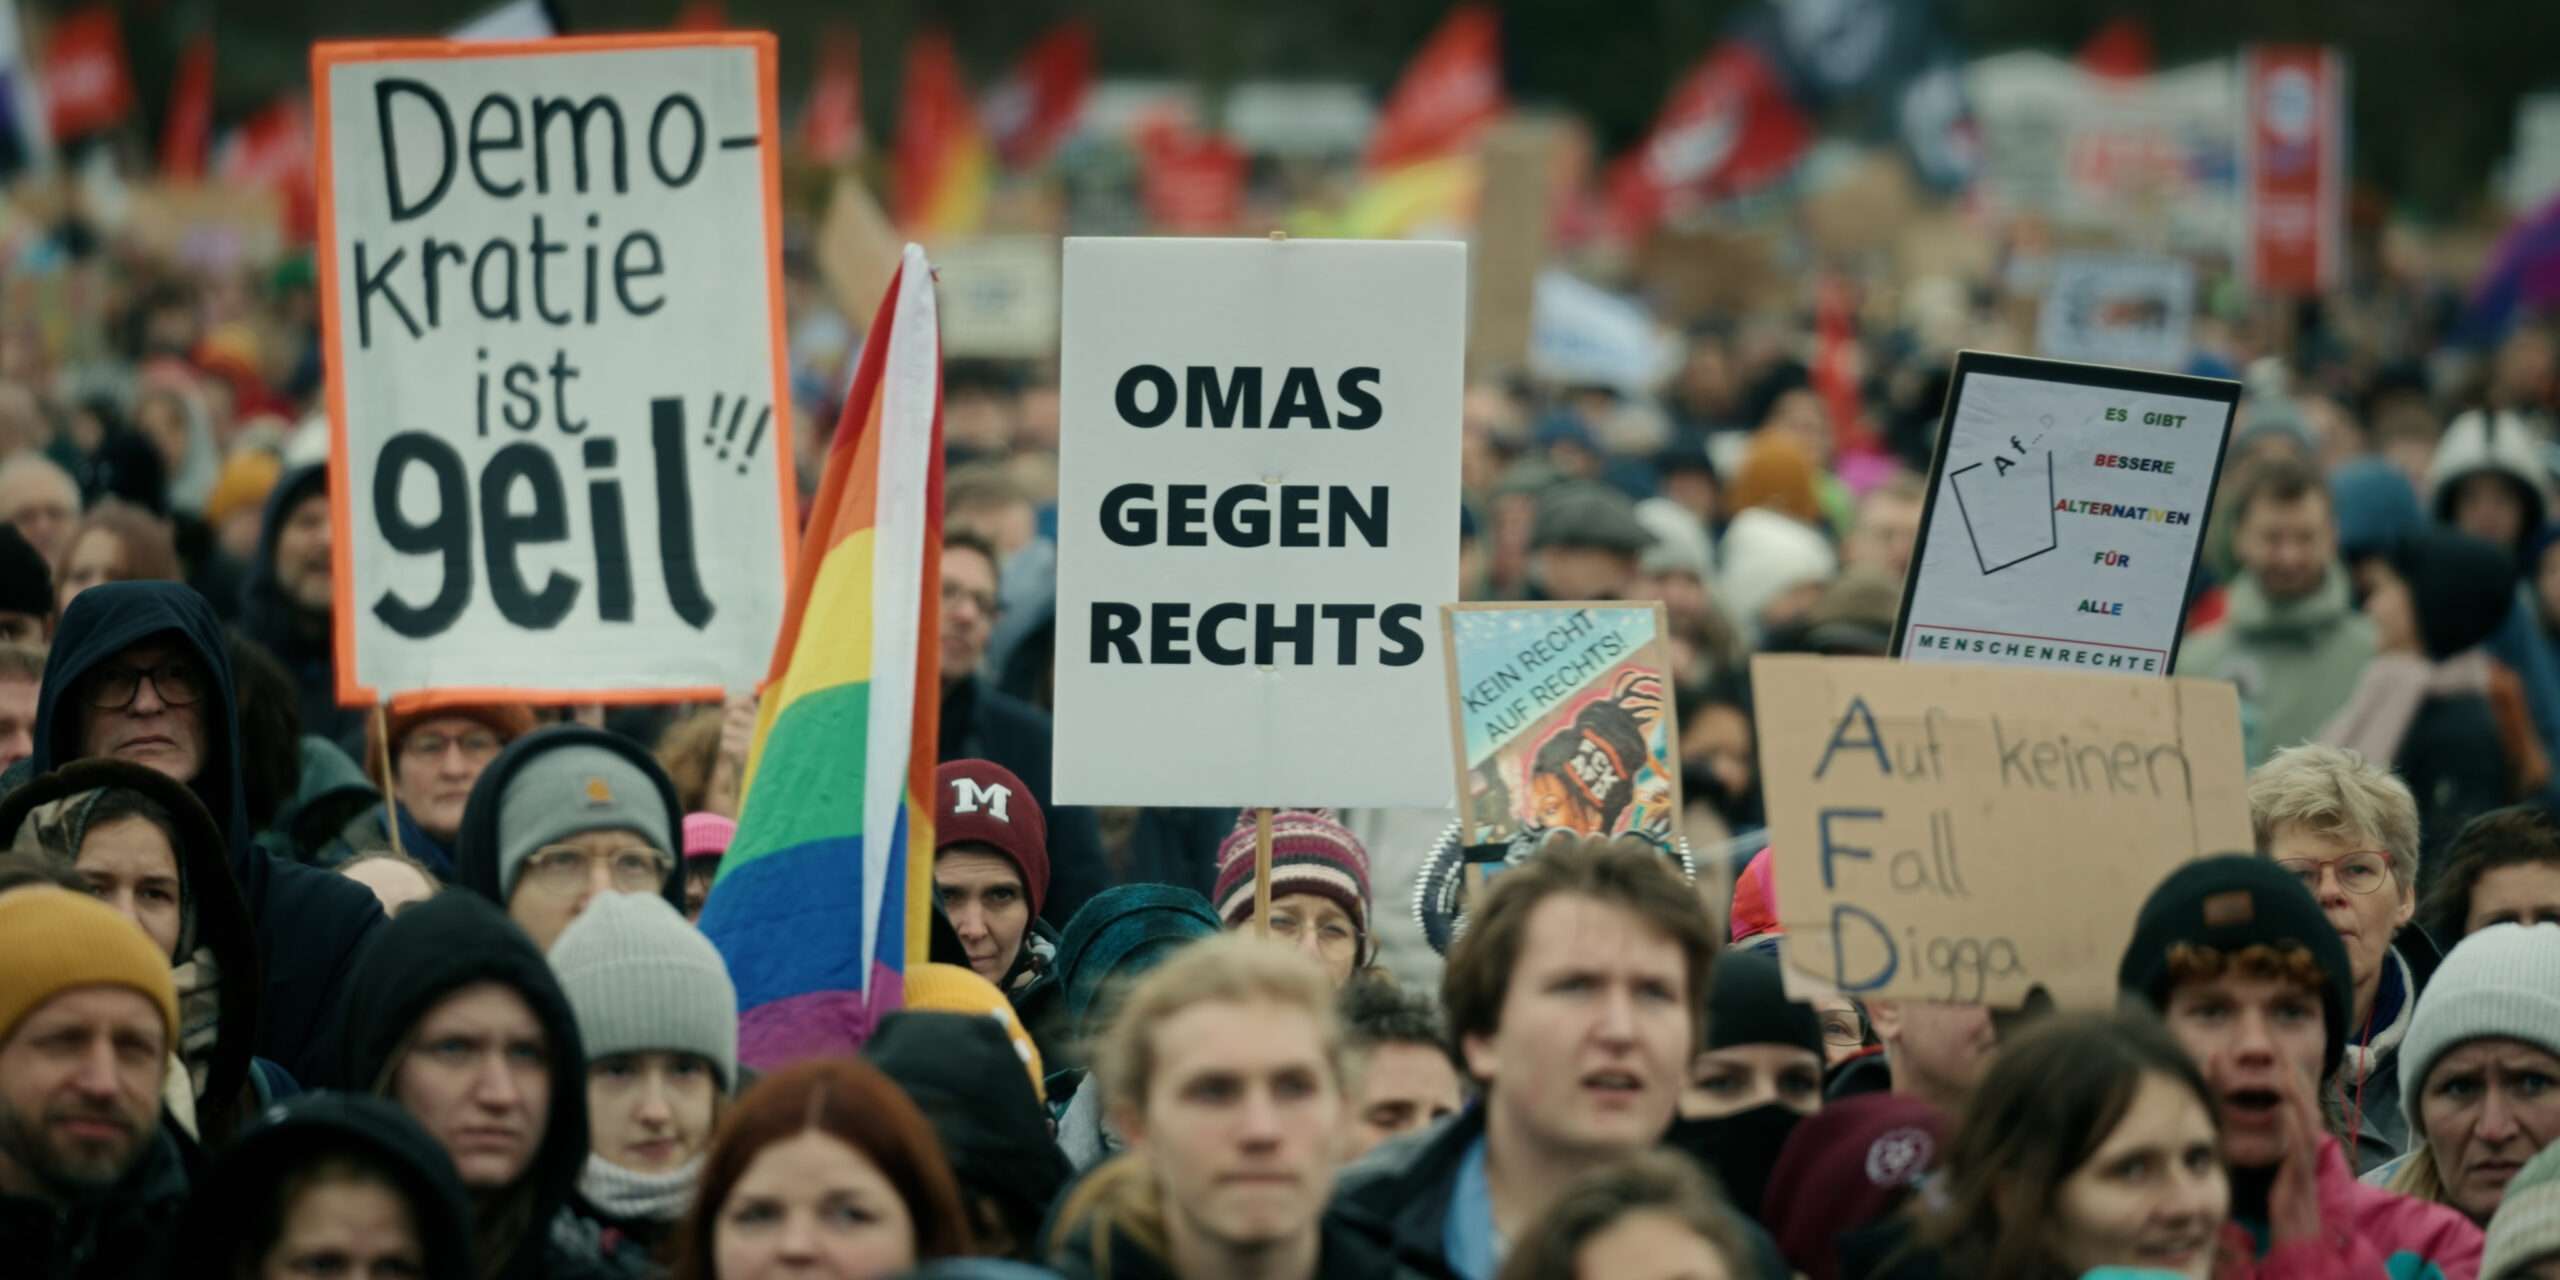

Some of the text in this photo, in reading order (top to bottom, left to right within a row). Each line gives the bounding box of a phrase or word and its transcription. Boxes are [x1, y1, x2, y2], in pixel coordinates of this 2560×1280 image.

[374, 77, 761, 222] Demo-
[477, 347, 588, 436] ist
[1115, 364, 1383, 430] OMAS
[2104, 407, 2187, 429] ES GIBT
[2093, 454, 2175, 475] BESSERE
[1099, 483, 1389, 548] GEGEN
[2054, 498, 2190, 526] ALTERNATIVEN
[2093, 550, 2130, 568] FÜR
[1090, 601, 1424, 666] RECHTS
[2078, 599, 2123, 616] ALLE
[1461, 608, 1596, 714] KEIN RECHT
[1918, 633, 2156, 672] MENSCHENRECHTE
[1484, 630, 1630, 743] AUF RECHTS!
[1812, 696, 2193, 804] Auf keinen
[951, 778, 1012, 823] M
[1818, 807, 1971, 897] Fall
[1832, 904, 2027, 1003] Digga
